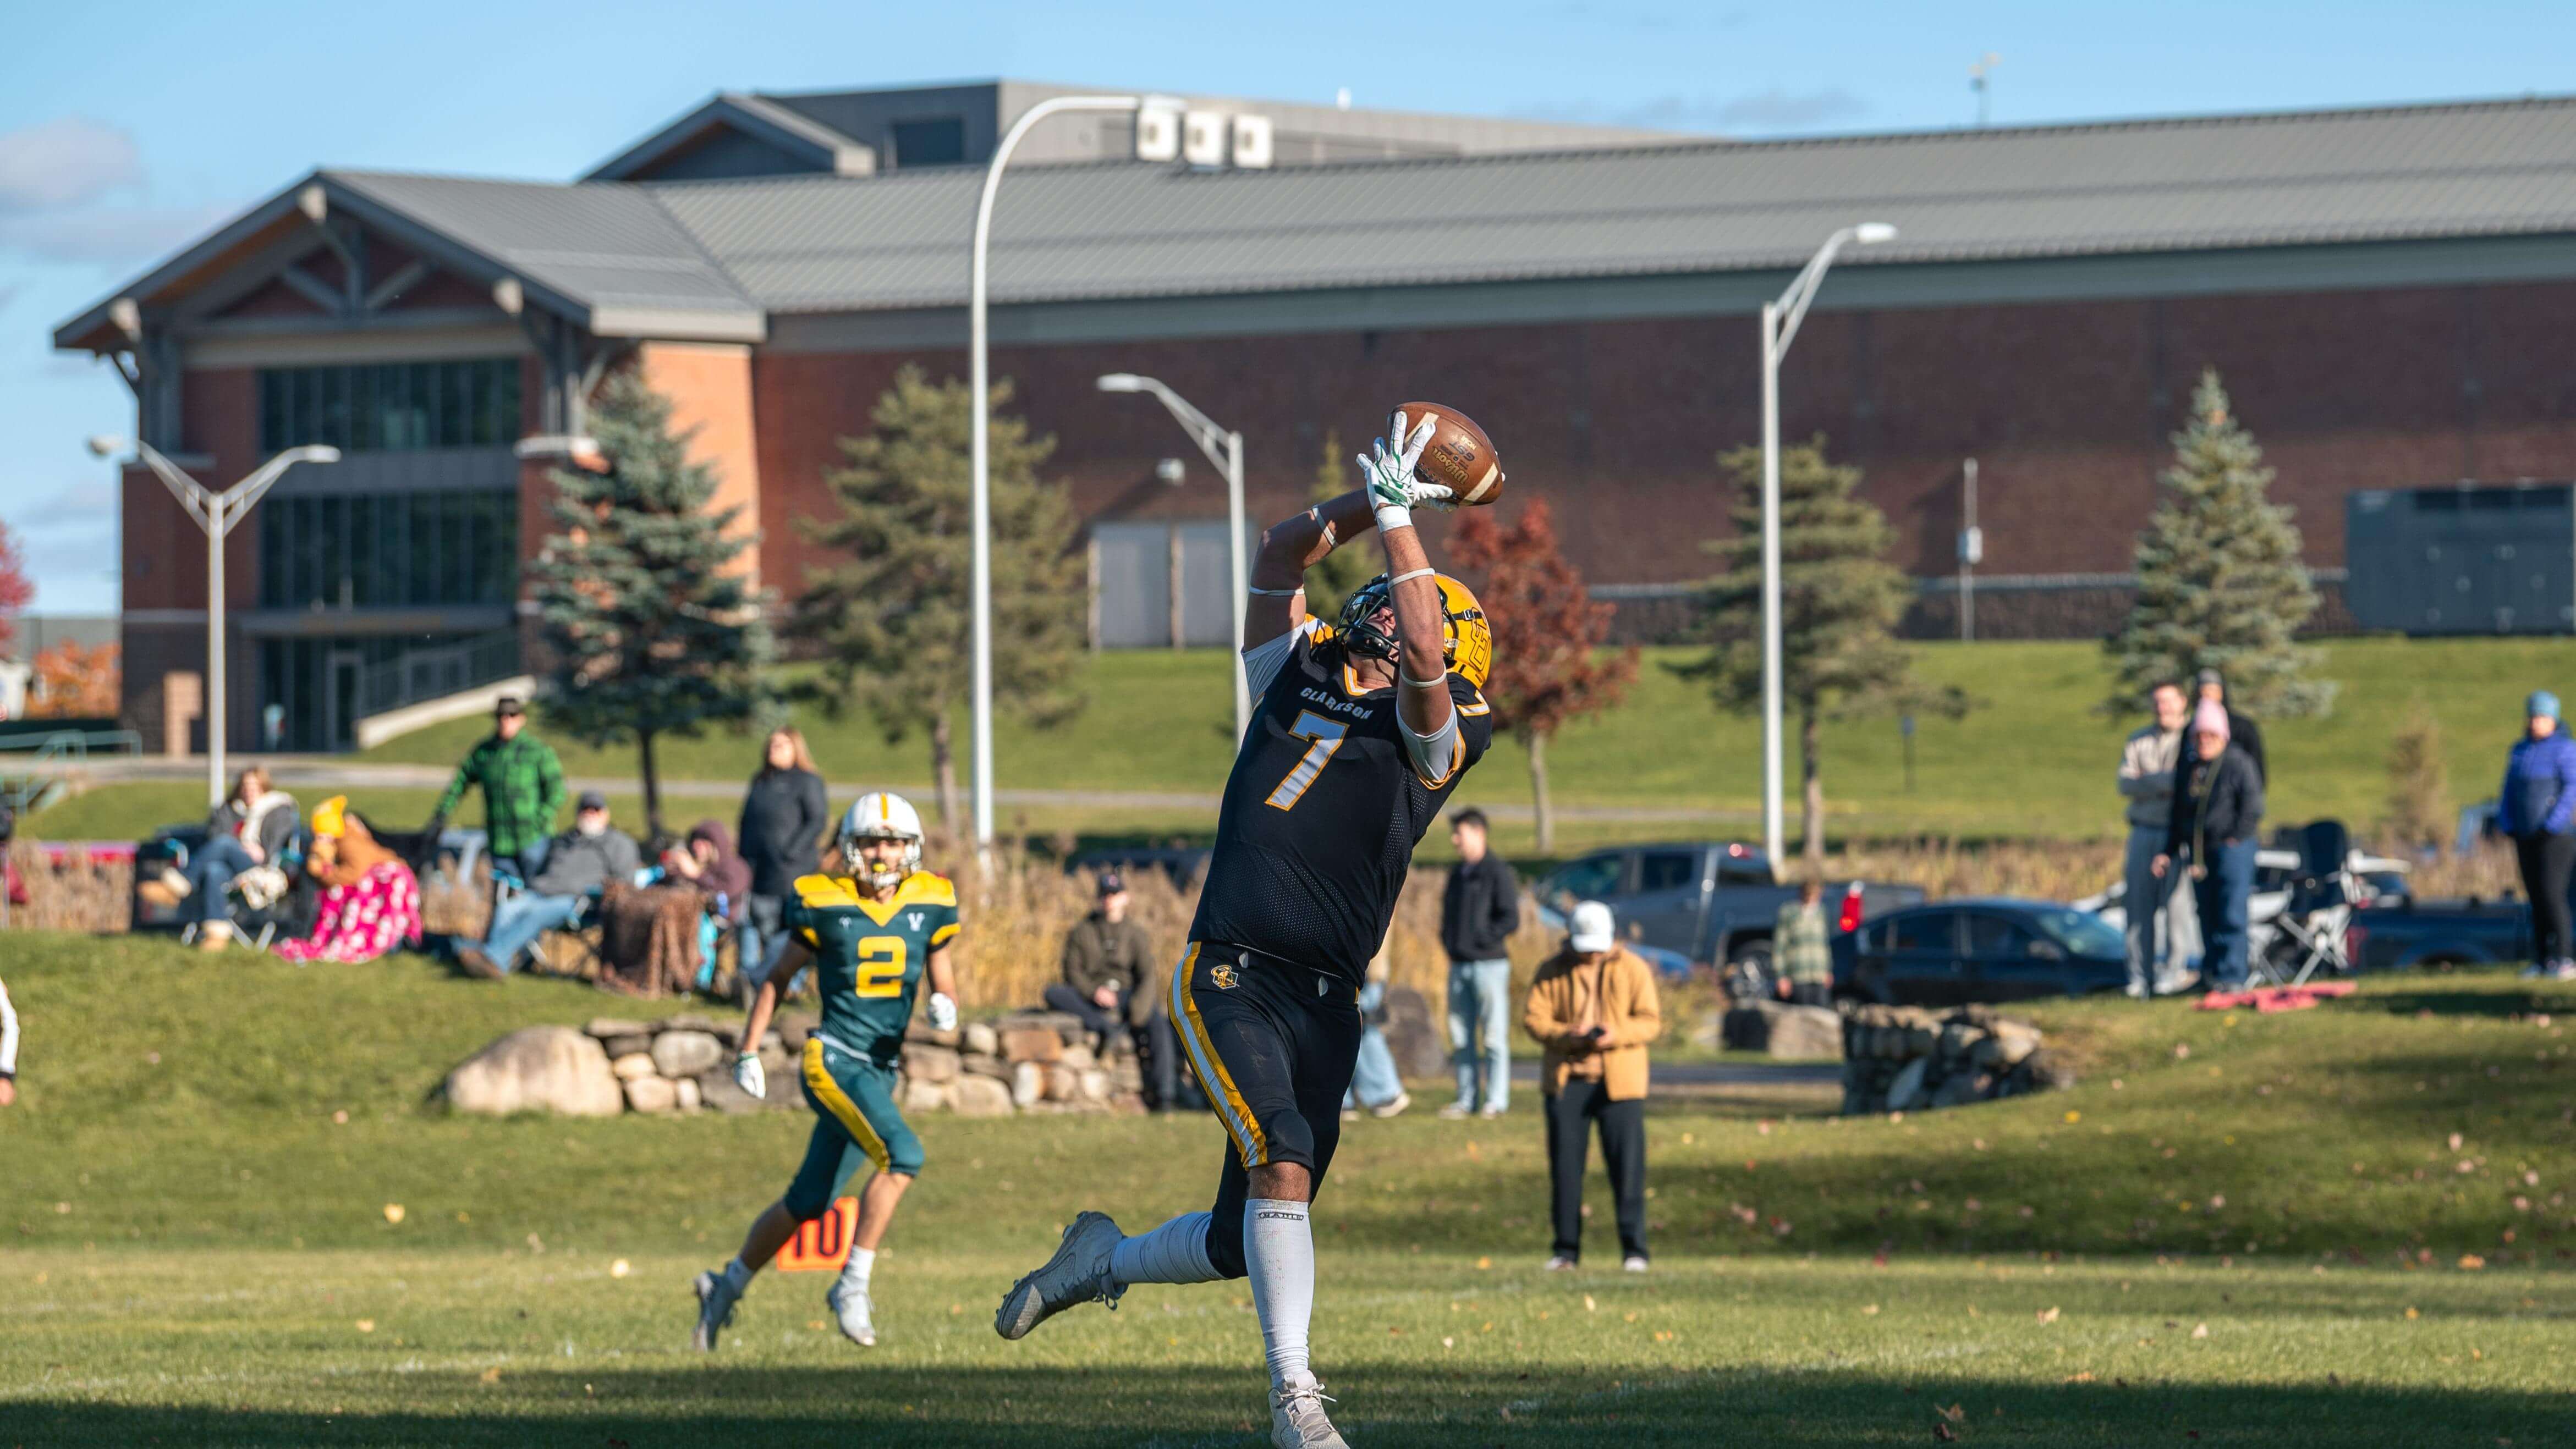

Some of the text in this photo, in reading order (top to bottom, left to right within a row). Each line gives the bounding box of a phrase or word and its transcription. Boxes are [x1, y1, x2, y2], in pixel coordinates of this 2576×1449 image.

[1433, 448, 1469, 484] Wilson
[1449, 441, 1474, 461] GST
[1299, 687, 1374, 720] CLARKSON
[1264, 708, 1350, 812] 7
[907, 912, 925, 932] V
[855, 935, 907, 998] 2
